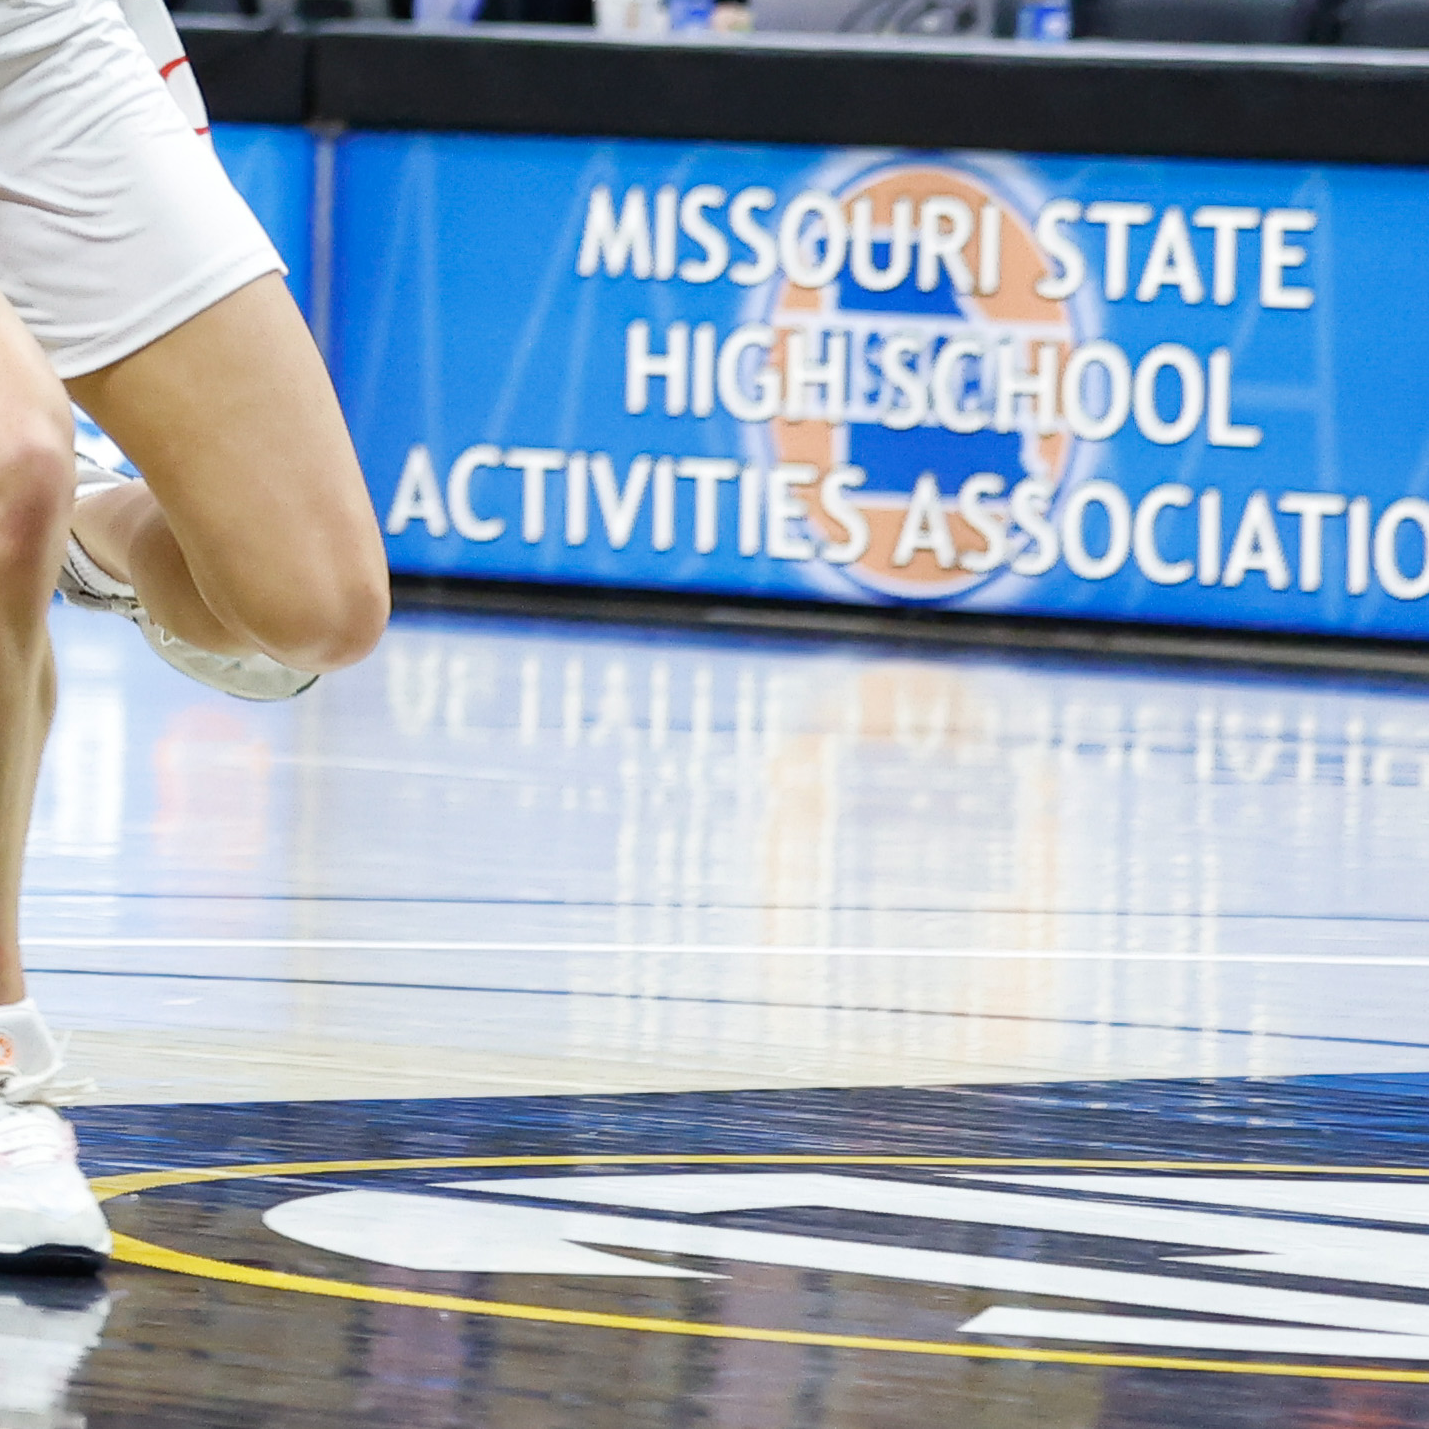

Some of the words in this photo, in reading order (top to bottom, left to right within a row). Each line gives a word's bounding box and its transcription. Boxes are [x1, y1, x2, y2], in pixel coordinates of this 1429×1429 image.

[576, 185, 1002, 296] MISSOURI
[1035, 199, 1318, 310] STATE
[625, 319, 848, 425] HIGH
[880, 335, 1263, 449] SCHOOL
[386, 444, 869, 566] ACTIVITIES
